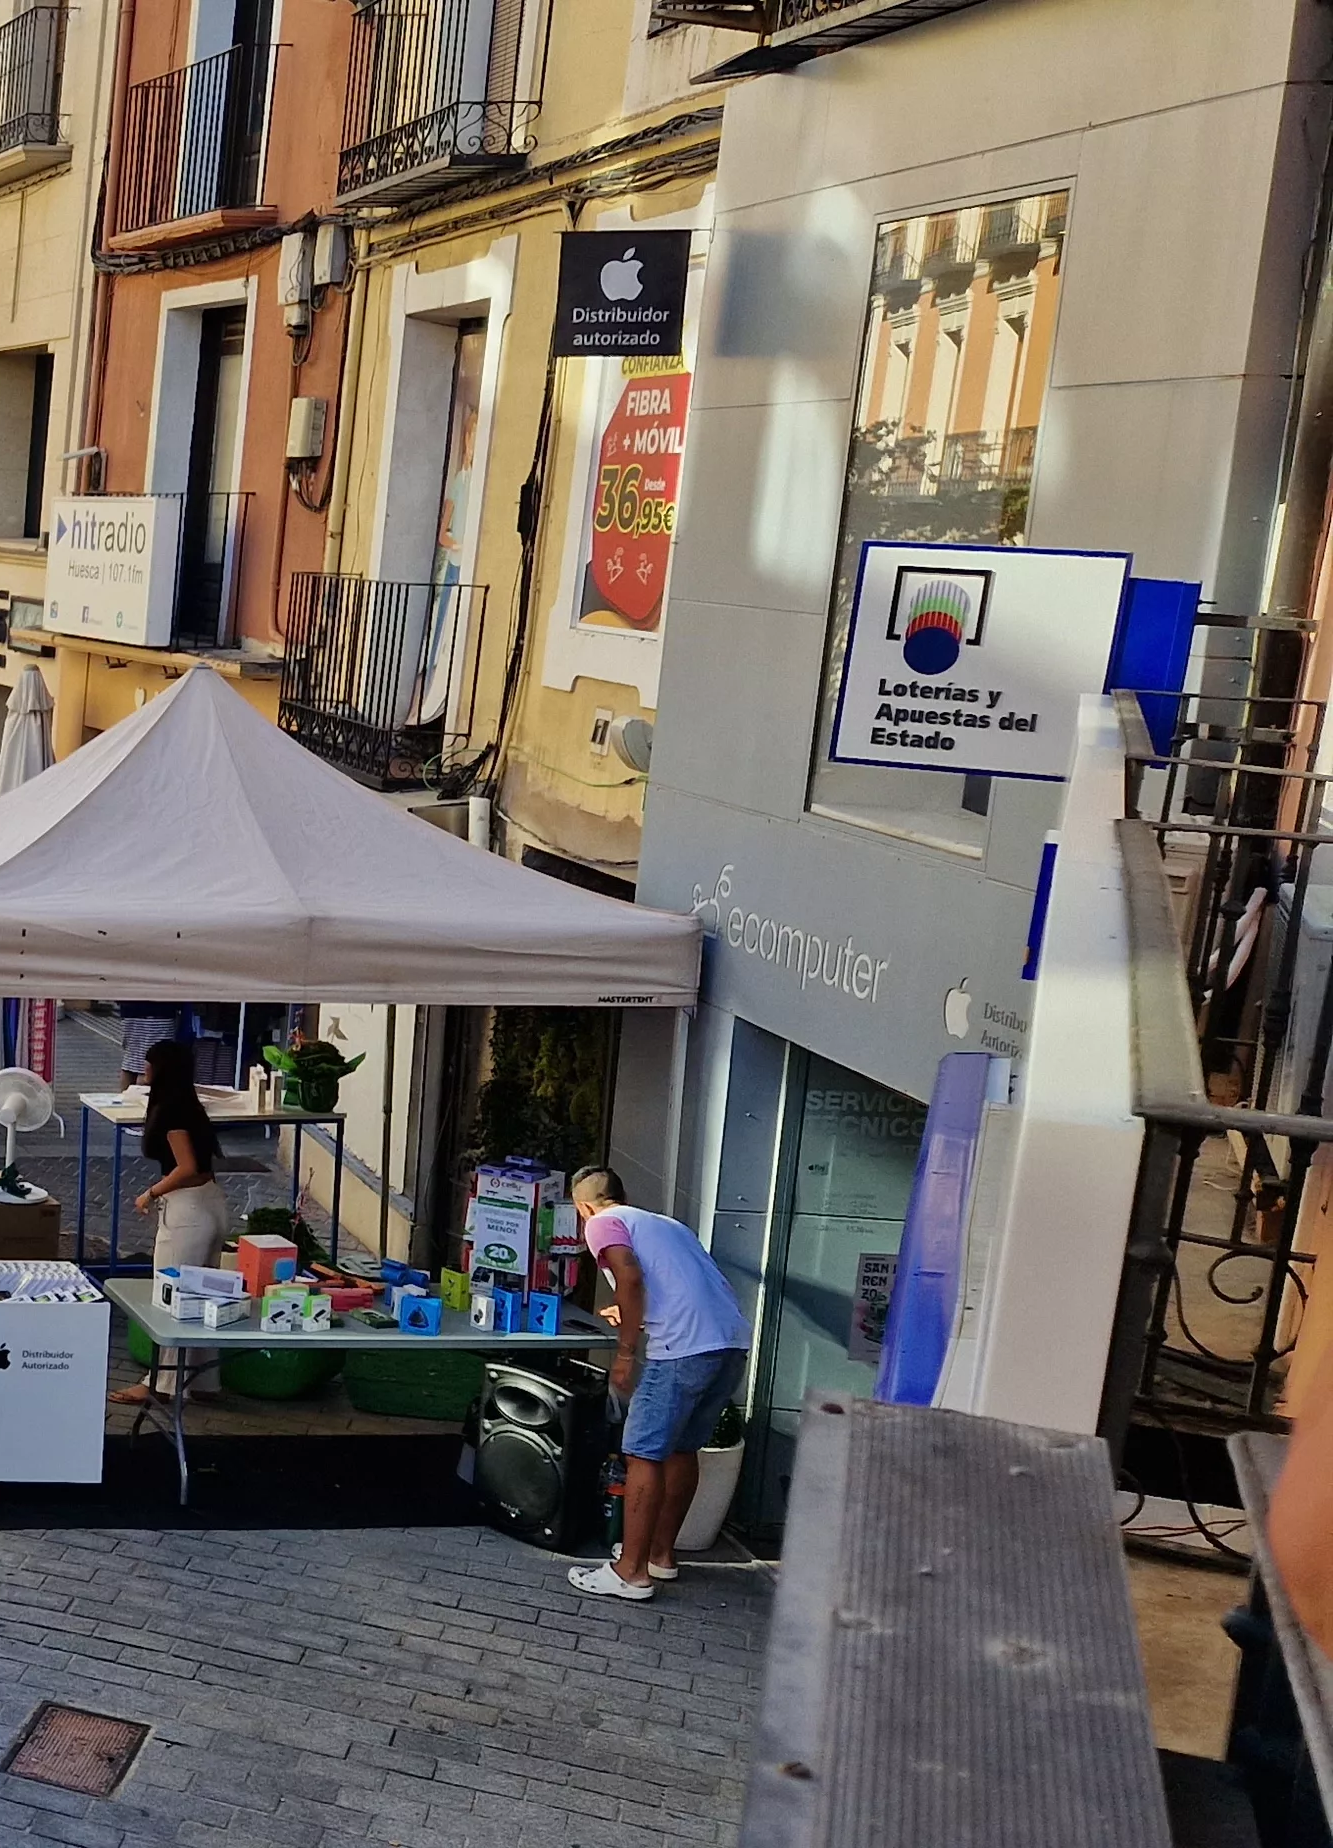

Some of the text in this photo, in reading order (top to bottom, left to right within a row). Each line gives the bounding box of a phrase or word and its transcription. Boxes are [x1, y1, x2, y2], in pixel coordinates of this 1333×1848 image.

[572, 307, 670, 323] Distribuidor
[573, 329, 660, 346] autorizado
[622, 356, 684, 375] CONFIANZA
[626, 388, 671, 417] FIBRA
[633, 423, 684, 455] MÓVIL
[71, 509, 146, 555] hitradio
[68, 560, 100, 580] Huesca
[878, 679, 1002, 709] Loterías y
[875, 703, 1038, 732] Apuestas del
[870, 727, 955, 751] Estado
[727, 906, 888, 1004] ecomputer
[598, 995, 654, 1004] MASTERTENT
[487, 1223, 517, 1235] MENOS
[863, 1263, 889, 1274] SAN
[862, 1276, 888, 1287] REN
[22, 1350, 74, 1360] Distribuidor
[21, 1362, 70, 1371] Autorizado
